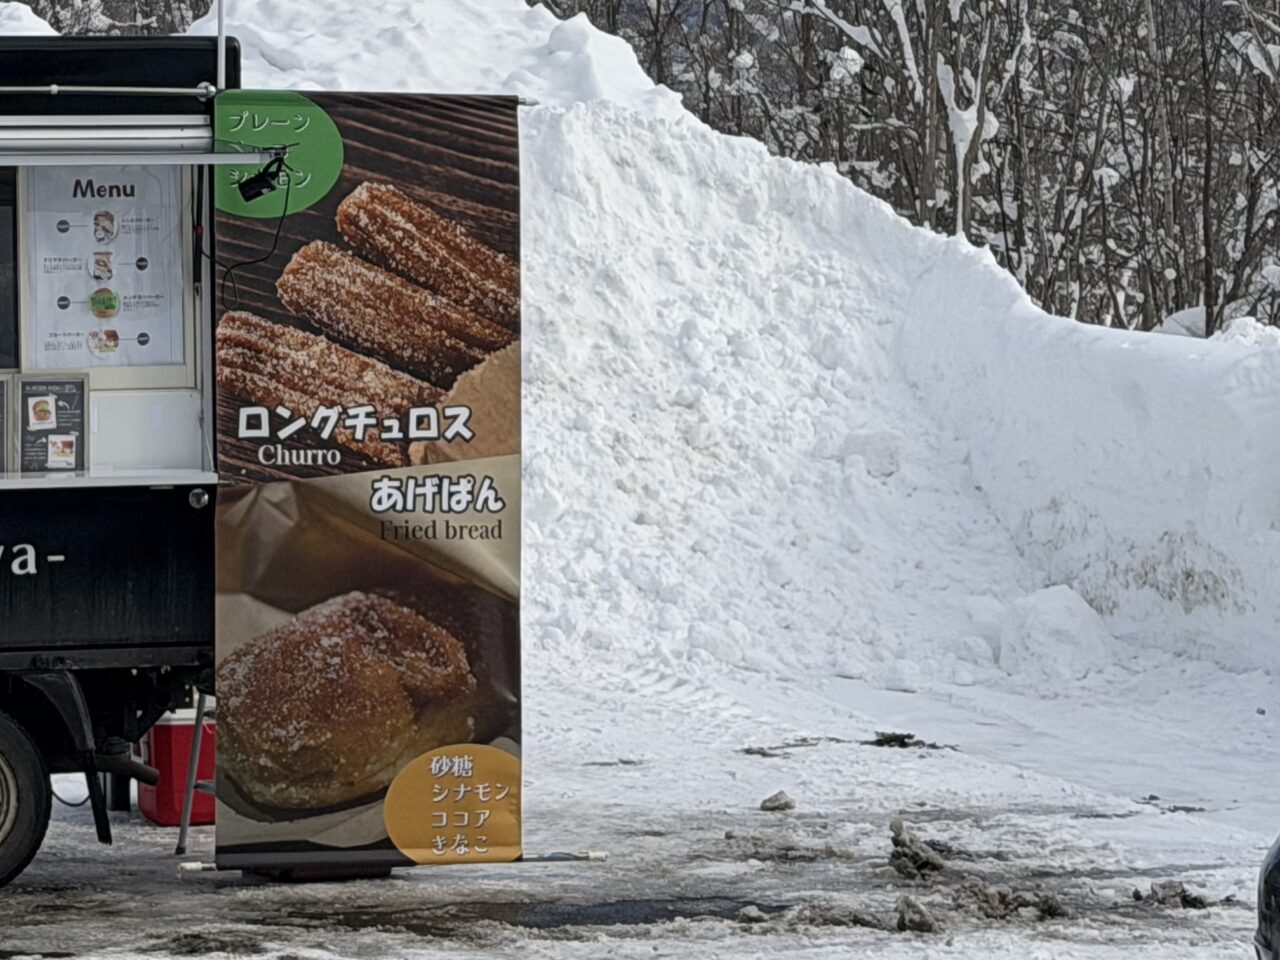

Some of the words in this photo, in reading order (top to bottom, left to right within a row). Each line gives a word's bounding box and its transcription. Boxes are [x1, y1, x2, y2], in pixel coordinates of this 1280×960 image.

[229, 111, 310, 132] プレーン
[73, 179, 135, 198] Menu
[229, 169, 311, 188] シモン
[237, 405, 476, 441] ロングチュロス
[258, 444, 341, 465] Churro
[370, 474, 506, 513] あげぱん
[380, 520, 437, 540] Fried
[445, 519, 503, 540] bread
[430, 755, 473, 777] 砂糖
[432, 783, 510, 802] シナモン
[432, 809, 490, 828] ココア
[432, 834, 489, 855] きなこ
